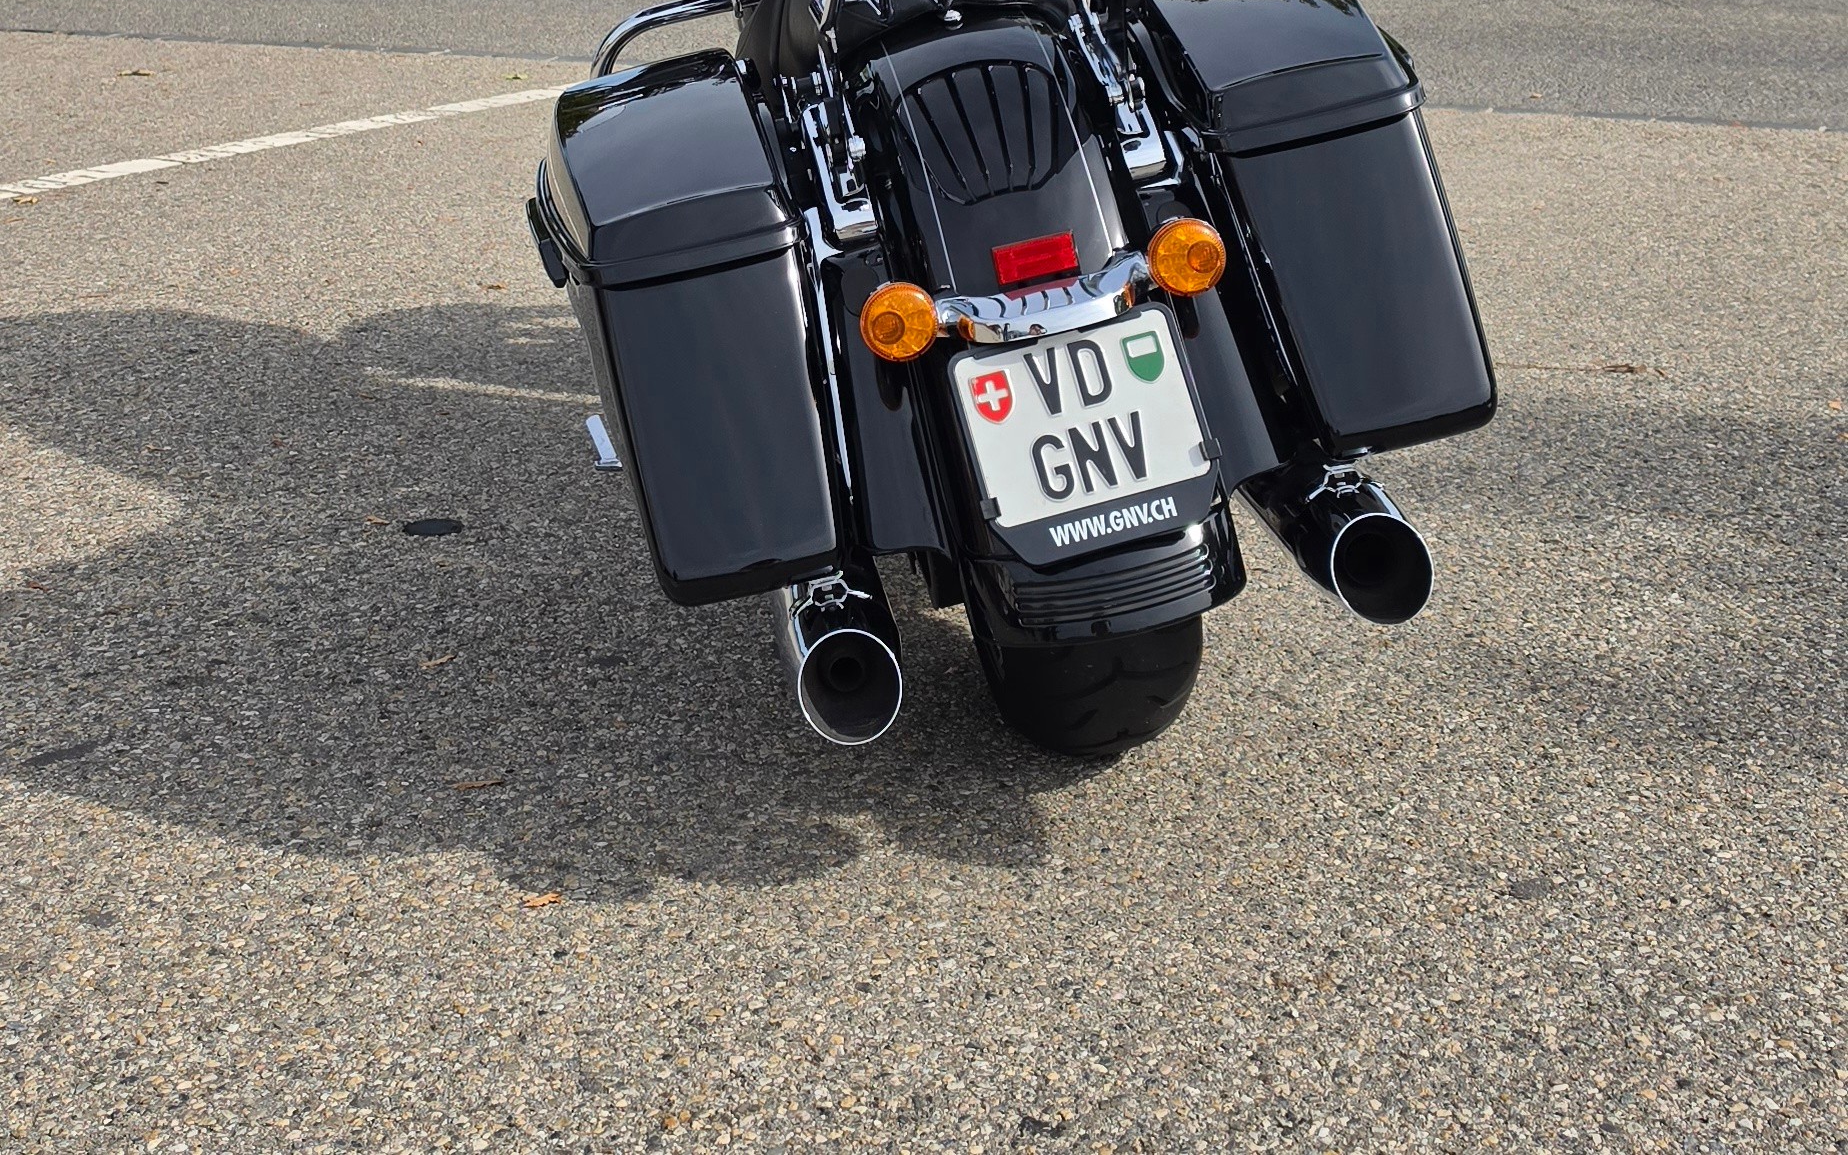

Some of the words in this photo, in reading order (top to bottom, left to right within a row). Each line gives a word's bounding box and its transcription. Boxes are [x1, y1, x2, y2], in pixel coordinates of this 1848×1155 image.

[1023, 339, 1113, 415] VD
[1031, 411, 1148, 500] GNV
[1049, 496, 1178, 547] WWW.GNV.CH
